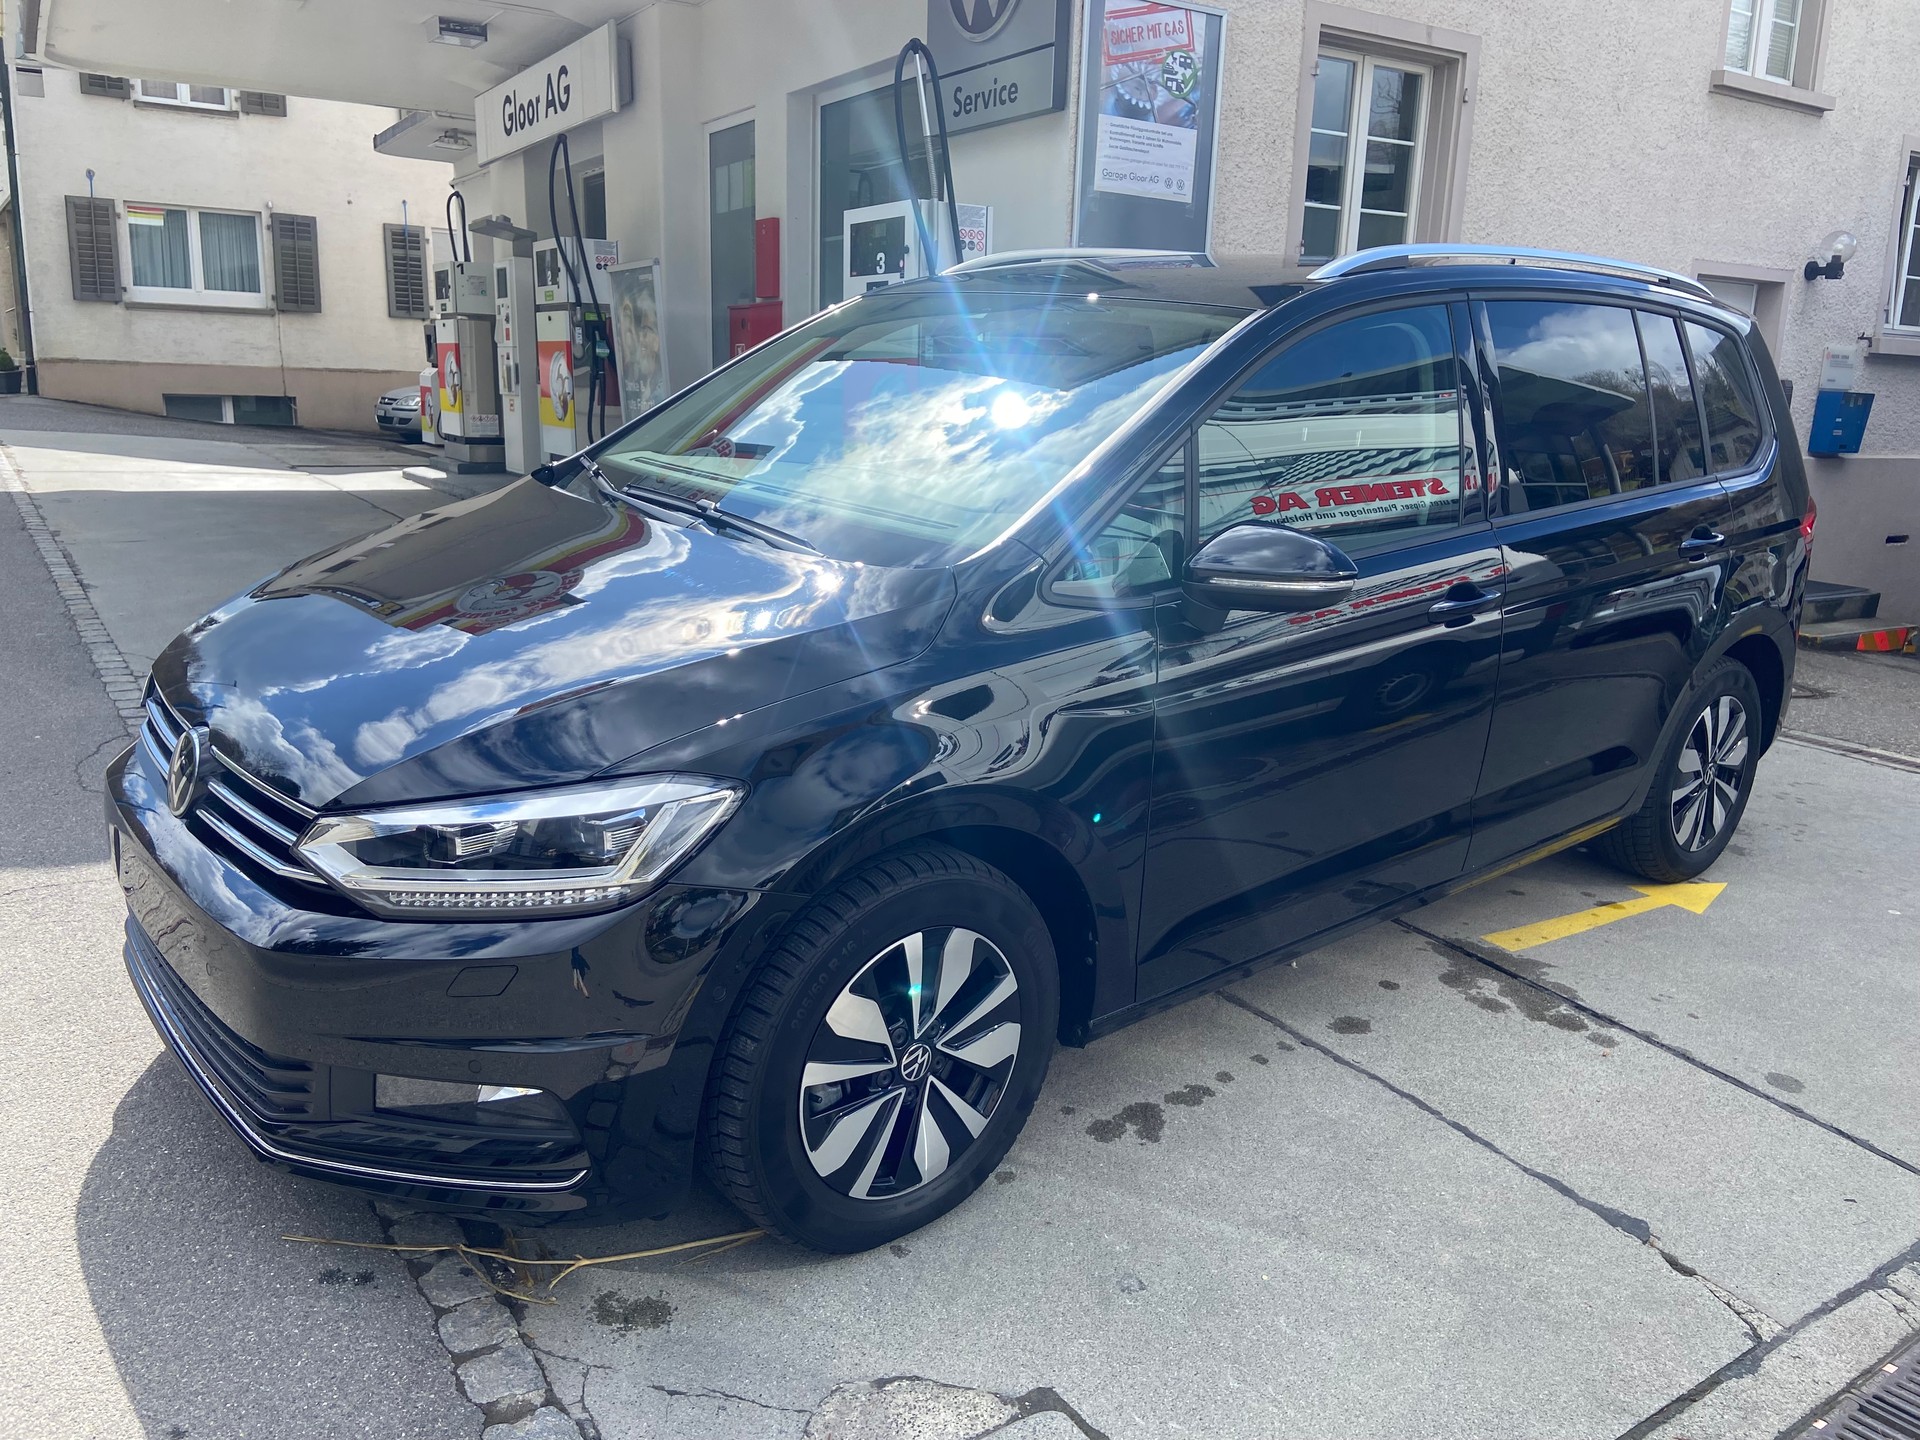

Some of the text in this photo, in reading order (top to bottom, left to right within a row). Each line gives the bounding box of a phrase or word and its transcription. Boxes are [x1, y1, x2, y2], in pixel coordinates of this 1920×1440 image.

[1110, 20, 1185, 46] SICHER MIT GAS
[502, 64, 571, 137] Gloor AG
[952, 77, 1019, 118] Service
[1102, 168, 1160, 184] Garage Gloor AG
[456, 263, 464, 275] 1
[876, 252, 886, 274] 3
